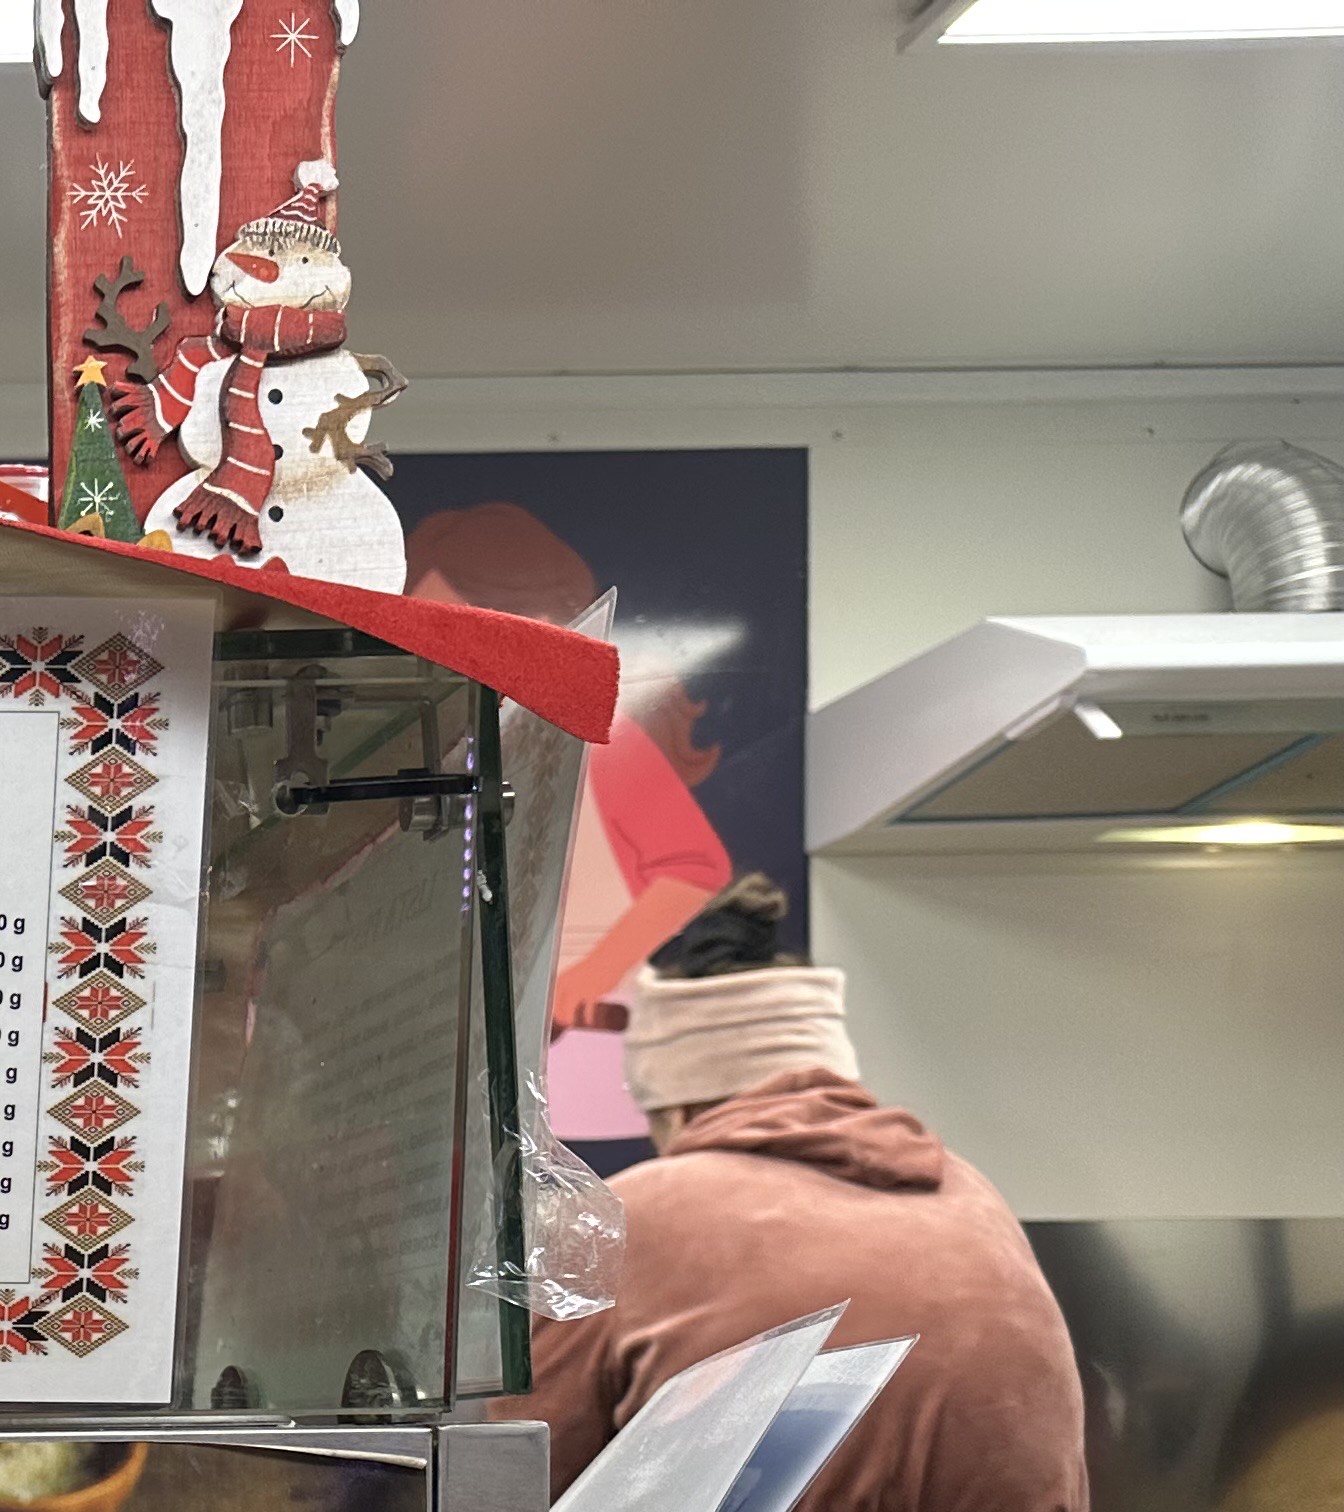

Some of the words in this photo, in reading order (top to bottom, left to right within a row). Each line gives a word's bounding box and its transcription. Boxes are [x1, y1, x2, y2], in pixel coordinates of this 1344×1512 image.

[13, 918, 24, 935] g
[12, 955, 23, 972] g
[10, 993, 21, 1010] g
[8, 1030, 19, 1047] g
[6, 1067, 17, 1084] g
[4, 1104, 16, 1121] g
[2, 1141, 14, 1157] g
[0, 1177, 12, 1194] g
